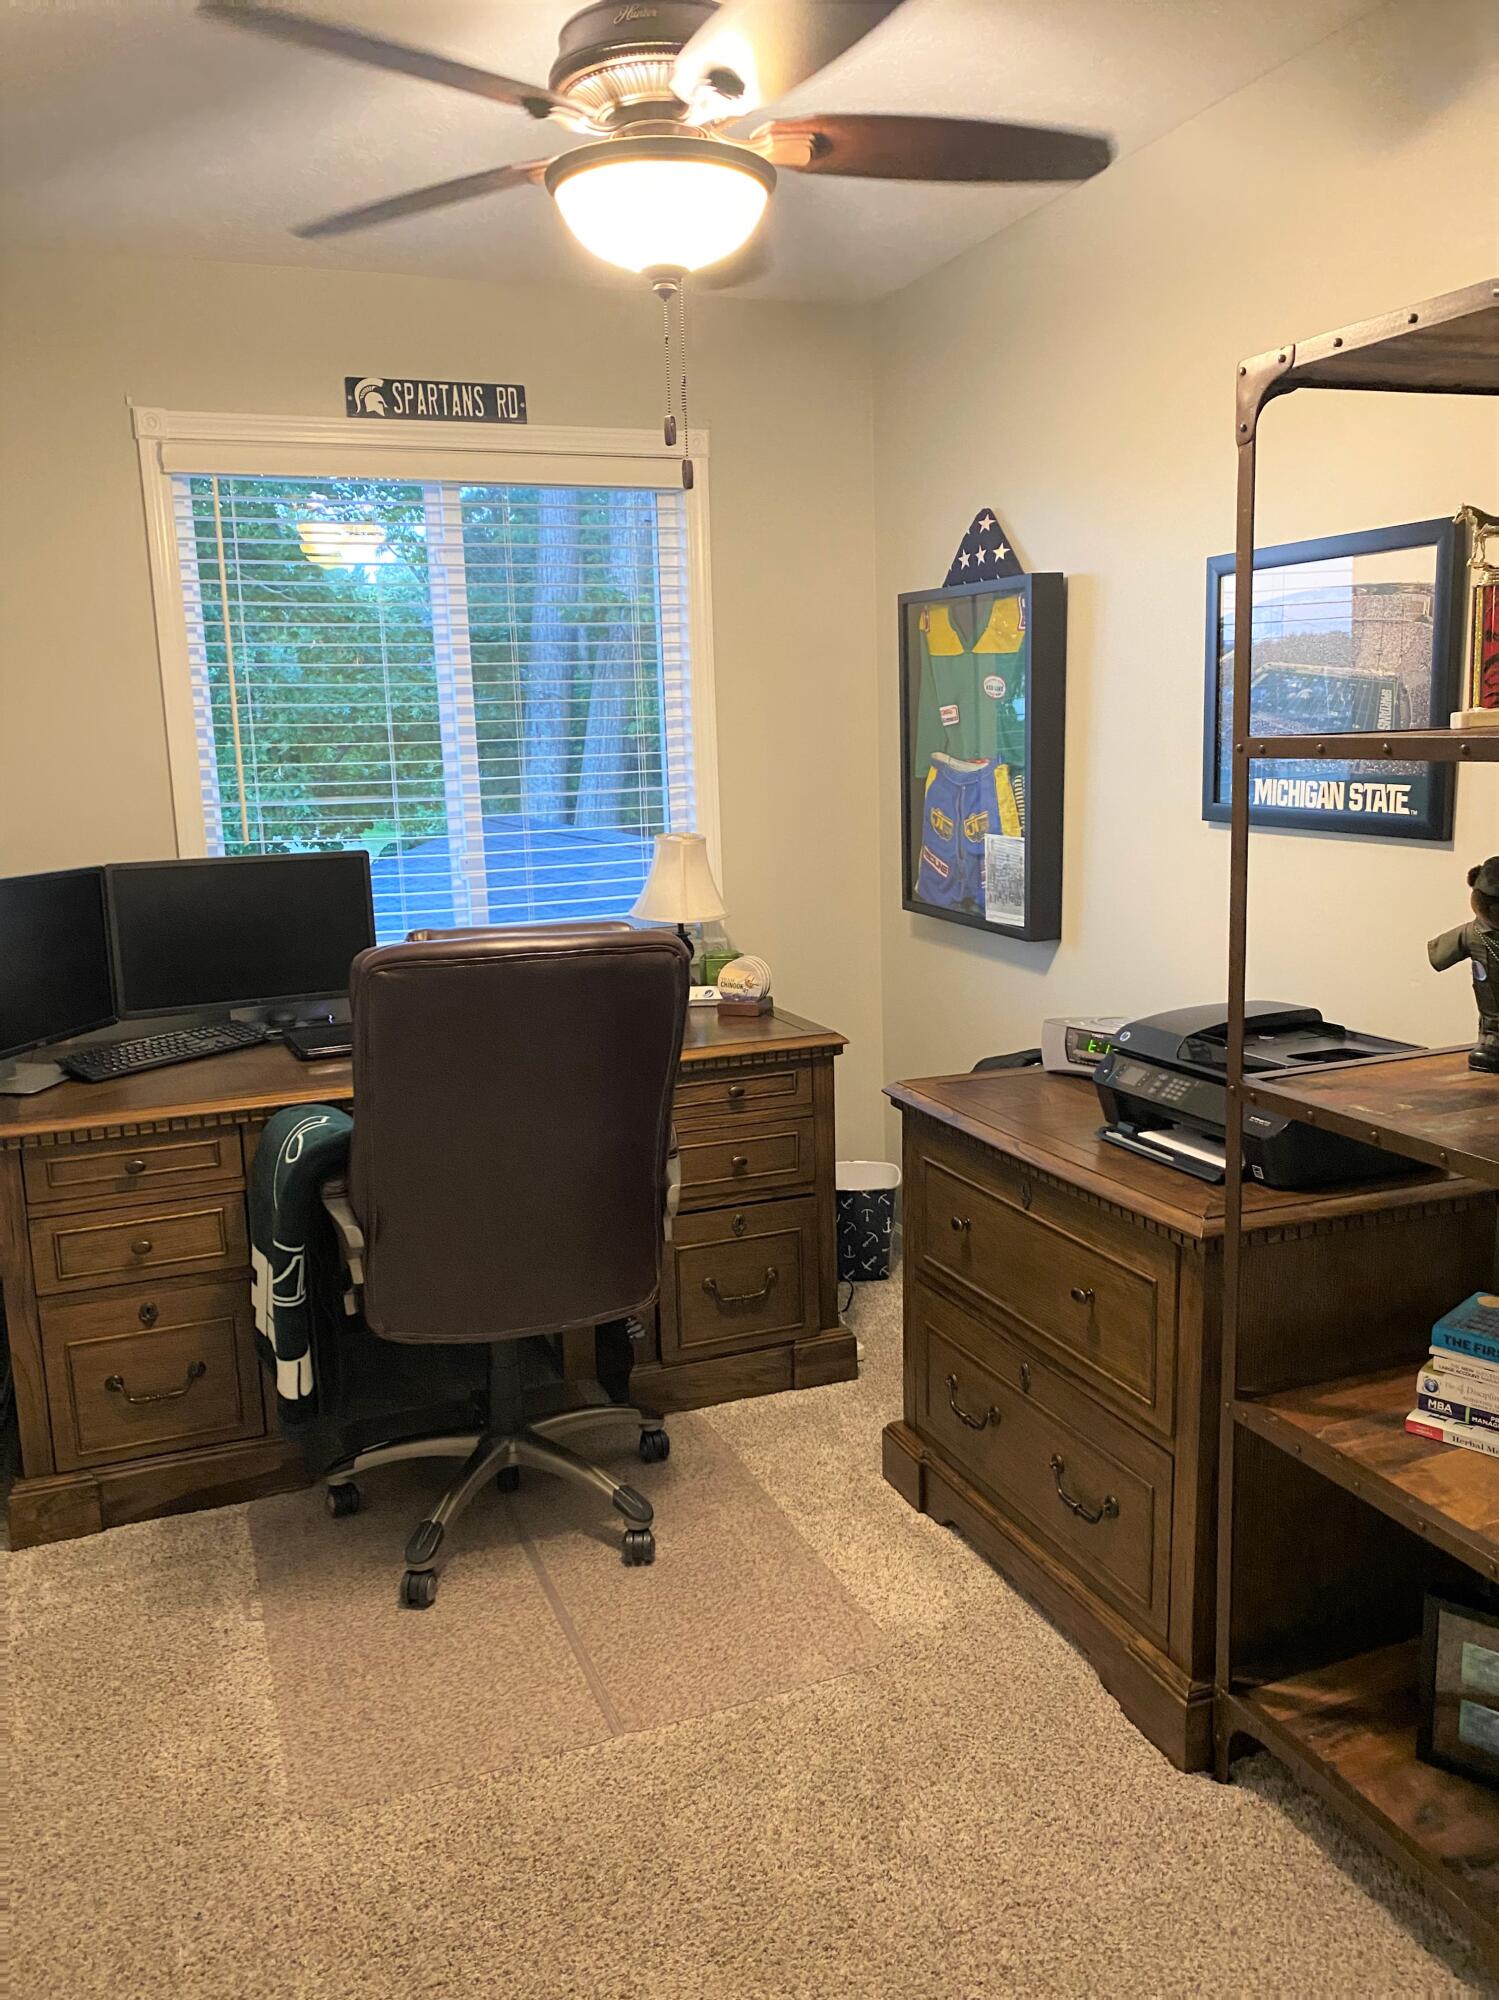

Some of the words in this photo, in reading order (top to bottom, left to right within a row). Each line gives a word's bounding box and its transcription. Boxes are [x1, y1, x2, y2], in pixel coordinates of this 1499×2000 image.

[392, 382, 484, 417] SPARTANS
[496, 387, 518, 418] RD
[1253, 778, 1345, 810] MICHIGAN
[1349, 782, 1412, 815] STATE
[1444, 1334, 1471, 1350] THE
[1428, 1398, 1452, 1415] MBA
[1451, 1435, 1484, 1450] Herbal
